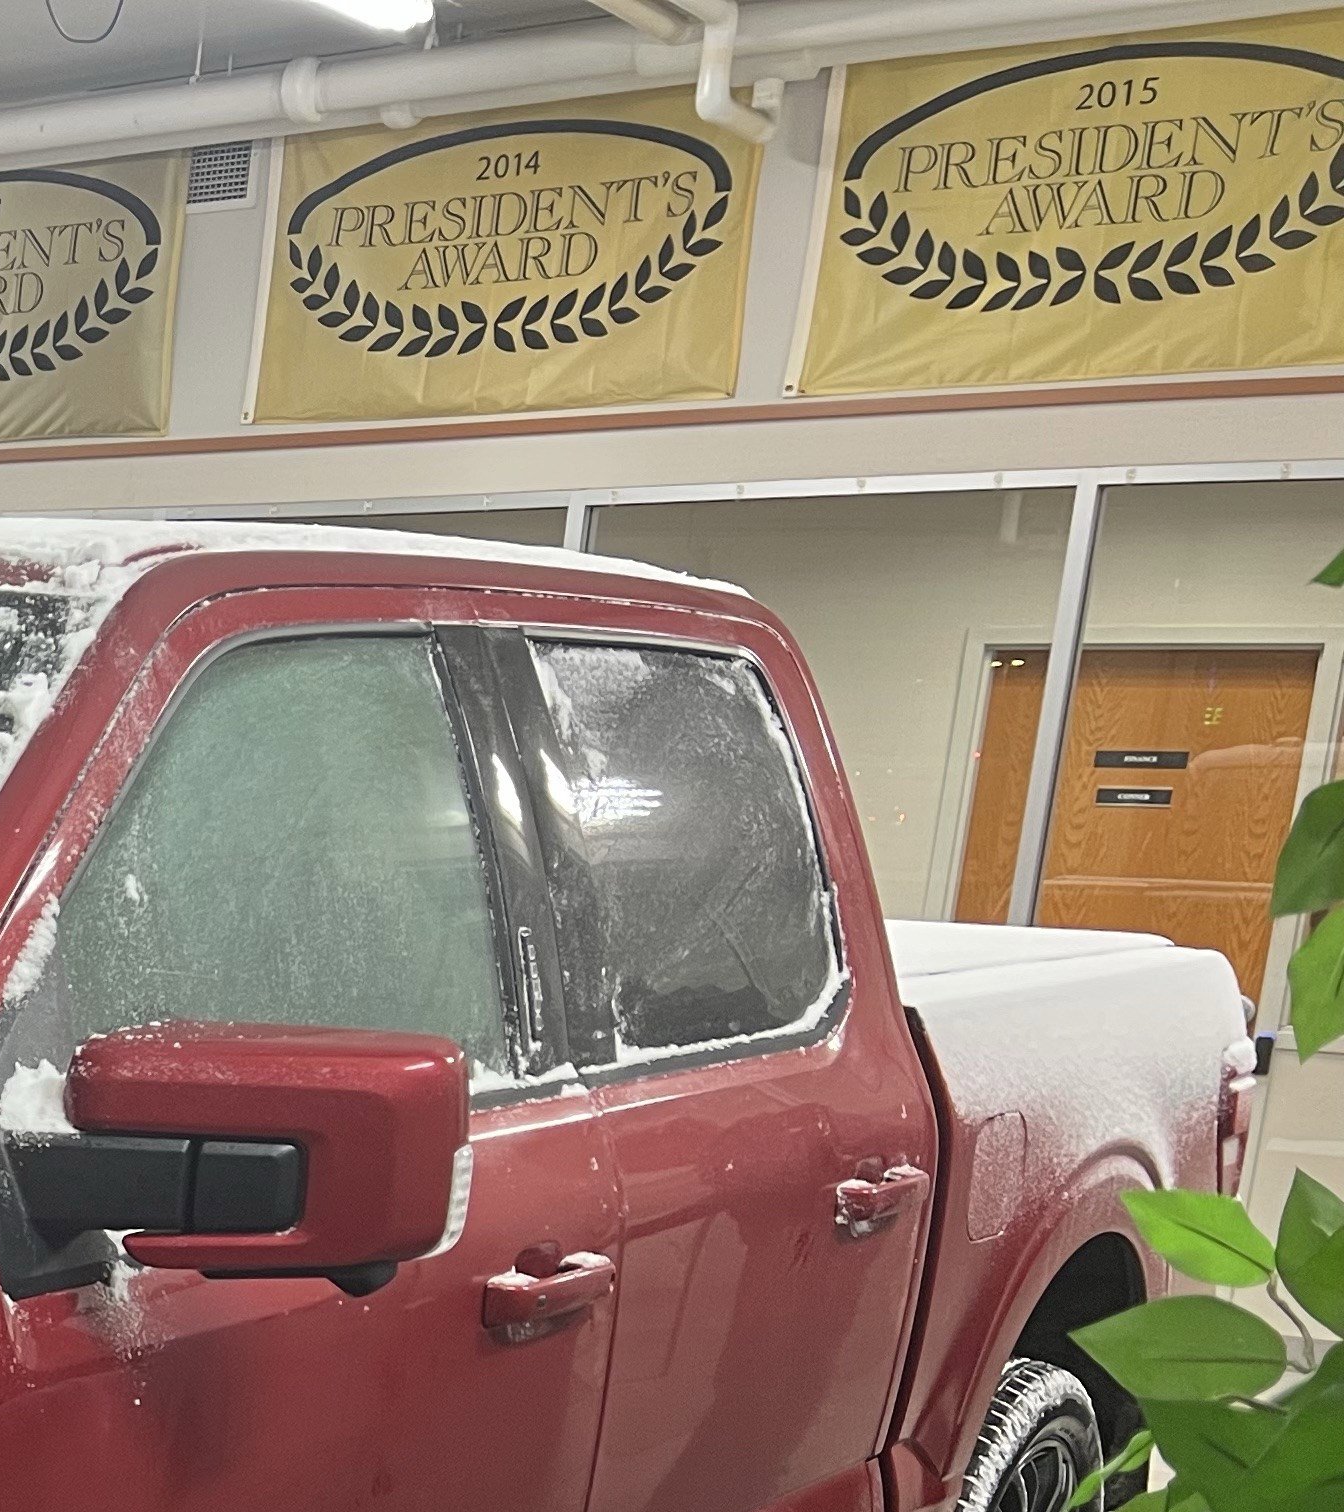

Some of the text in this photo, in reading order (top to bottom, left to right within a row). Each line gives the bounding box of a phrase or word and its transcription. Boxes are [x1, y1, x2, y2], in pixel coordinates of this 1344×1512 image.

[1074, 76, 1161, 111] 2015
[474, 150, 541, 182] 2014
[892, 99, 1344, 194] PRESIDENT'S
[325, 170, 699, 249] PRESIDENT'S
[975, 170, 1227, 237] AWARD
[396, 231, 599, 292] AWARD
